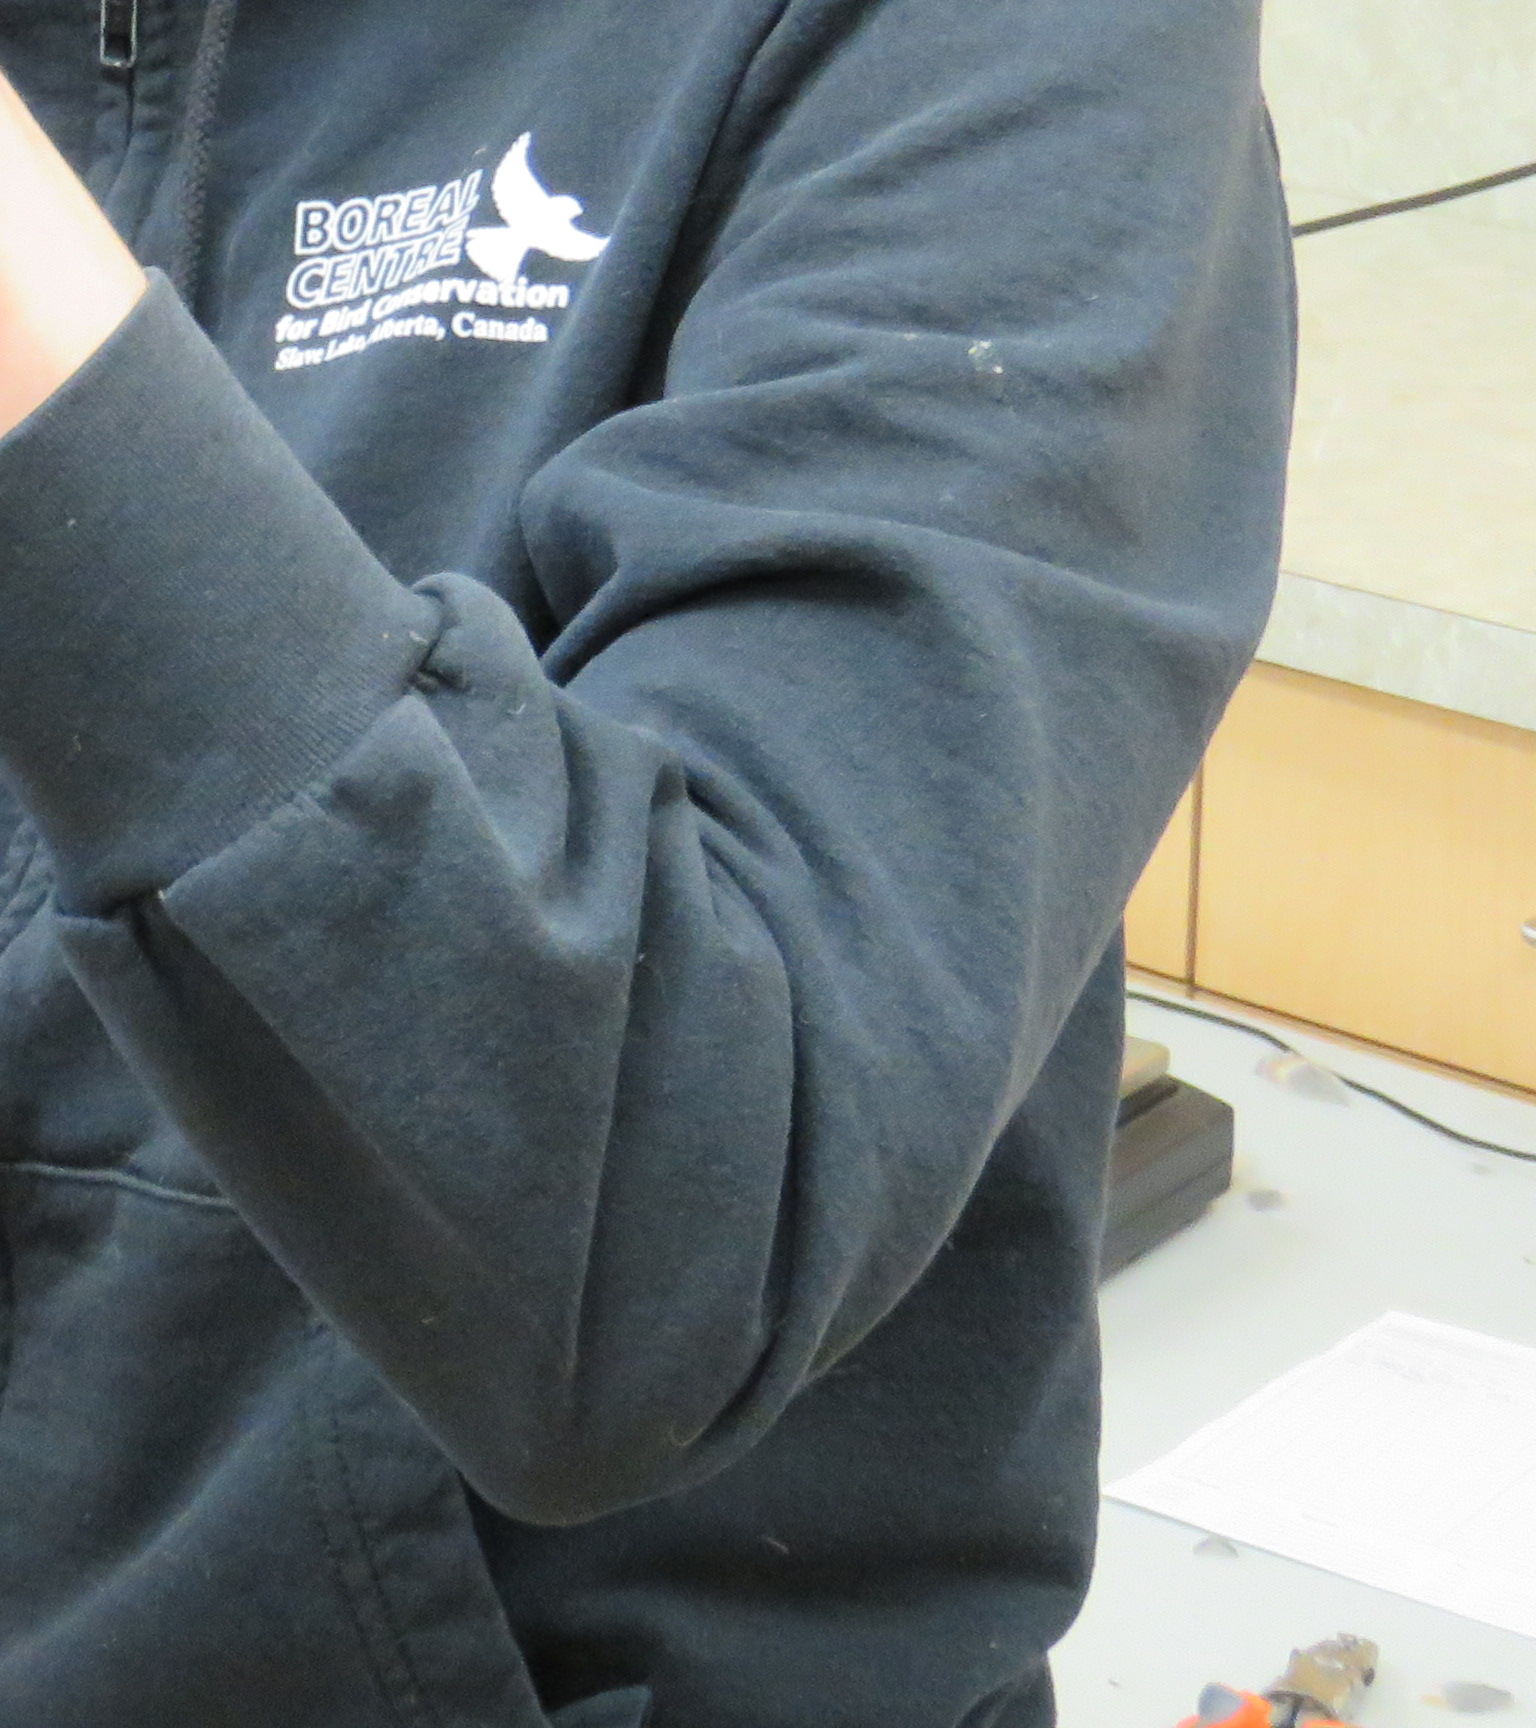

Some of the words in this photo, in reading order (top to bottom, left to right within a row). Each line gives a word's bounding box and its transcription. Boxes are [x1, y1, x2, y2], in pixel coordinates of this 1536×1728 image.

[294, 169, 484, 256] BOREAL
[286, 214, 471, 310] CENTRE
[274, 345, 325, 370] Slave
[451, 311, 549, 343] Canada
[275, 314, 319, 342] for
[319, 298, 373, 337] Bird
[372, 275, 570, 321] Conservation
